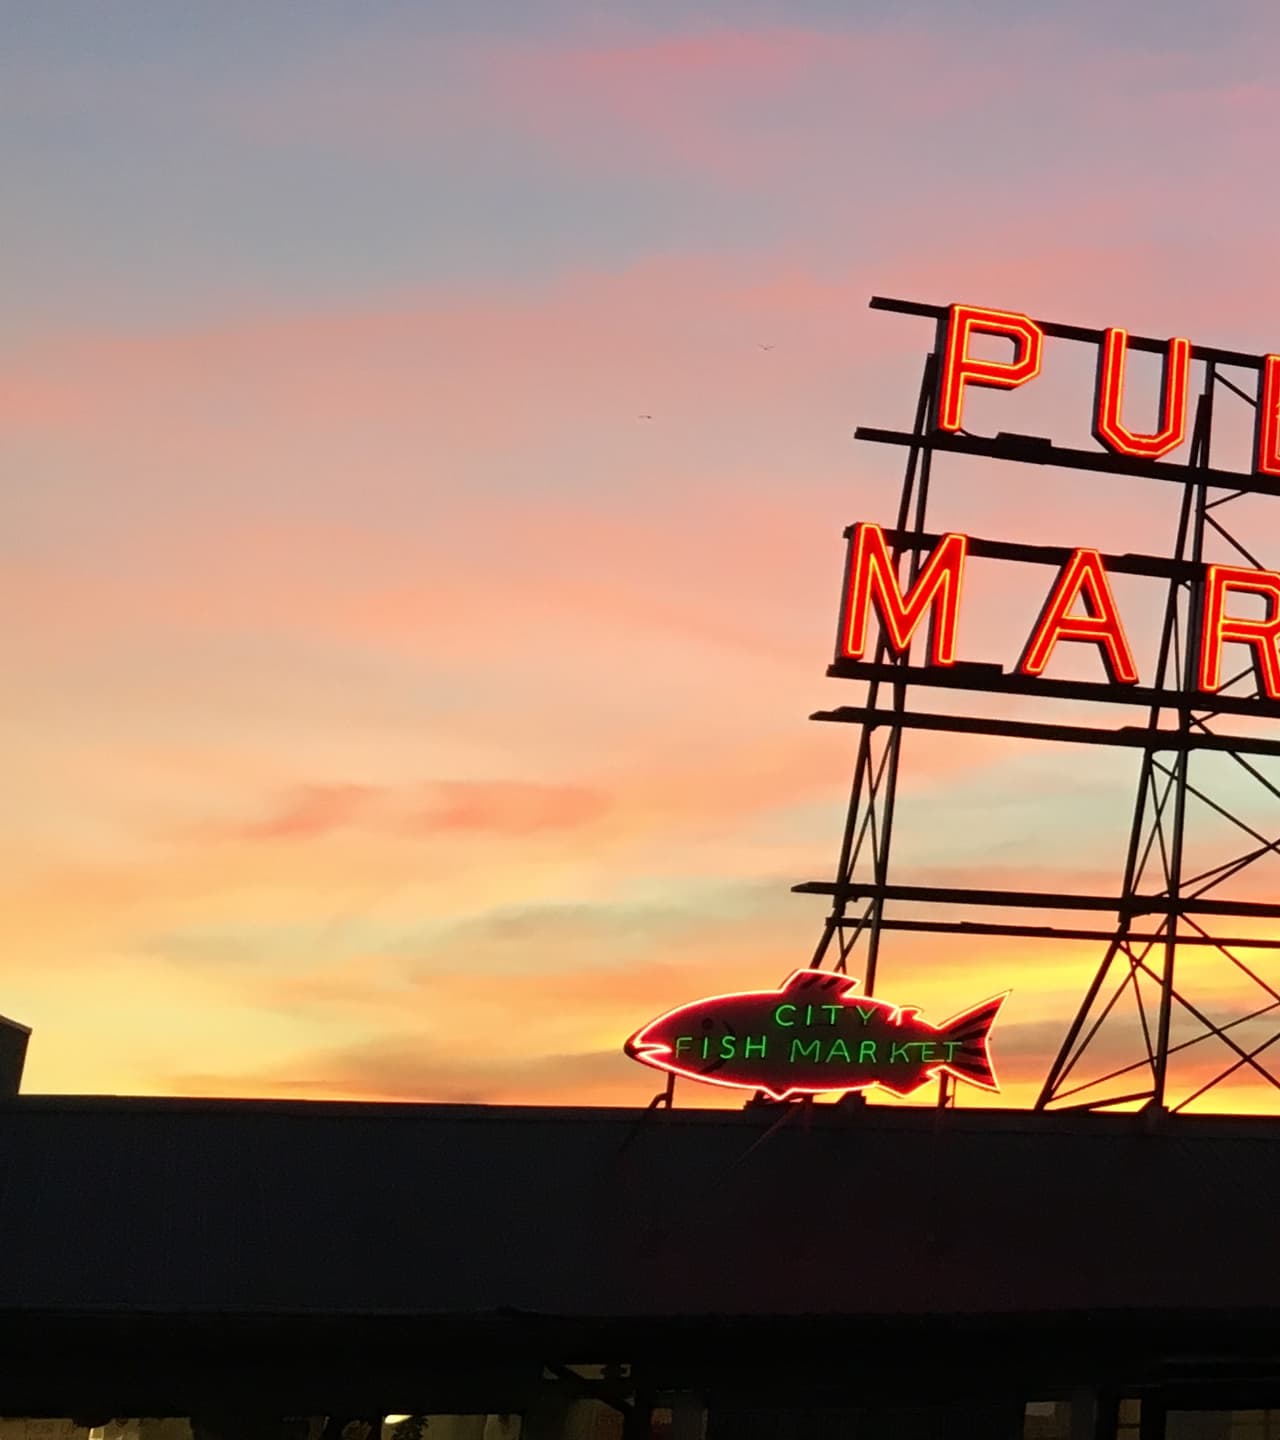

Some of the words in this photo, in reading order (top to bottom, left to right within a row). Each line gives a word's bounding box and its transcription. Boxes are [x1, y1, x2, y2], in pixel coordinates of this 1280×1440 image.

[774, 1004, 877, 1027] CITY
[675, 1035, 768, 1060] FISH
[789, 1038, 963, 1064] MARKET
